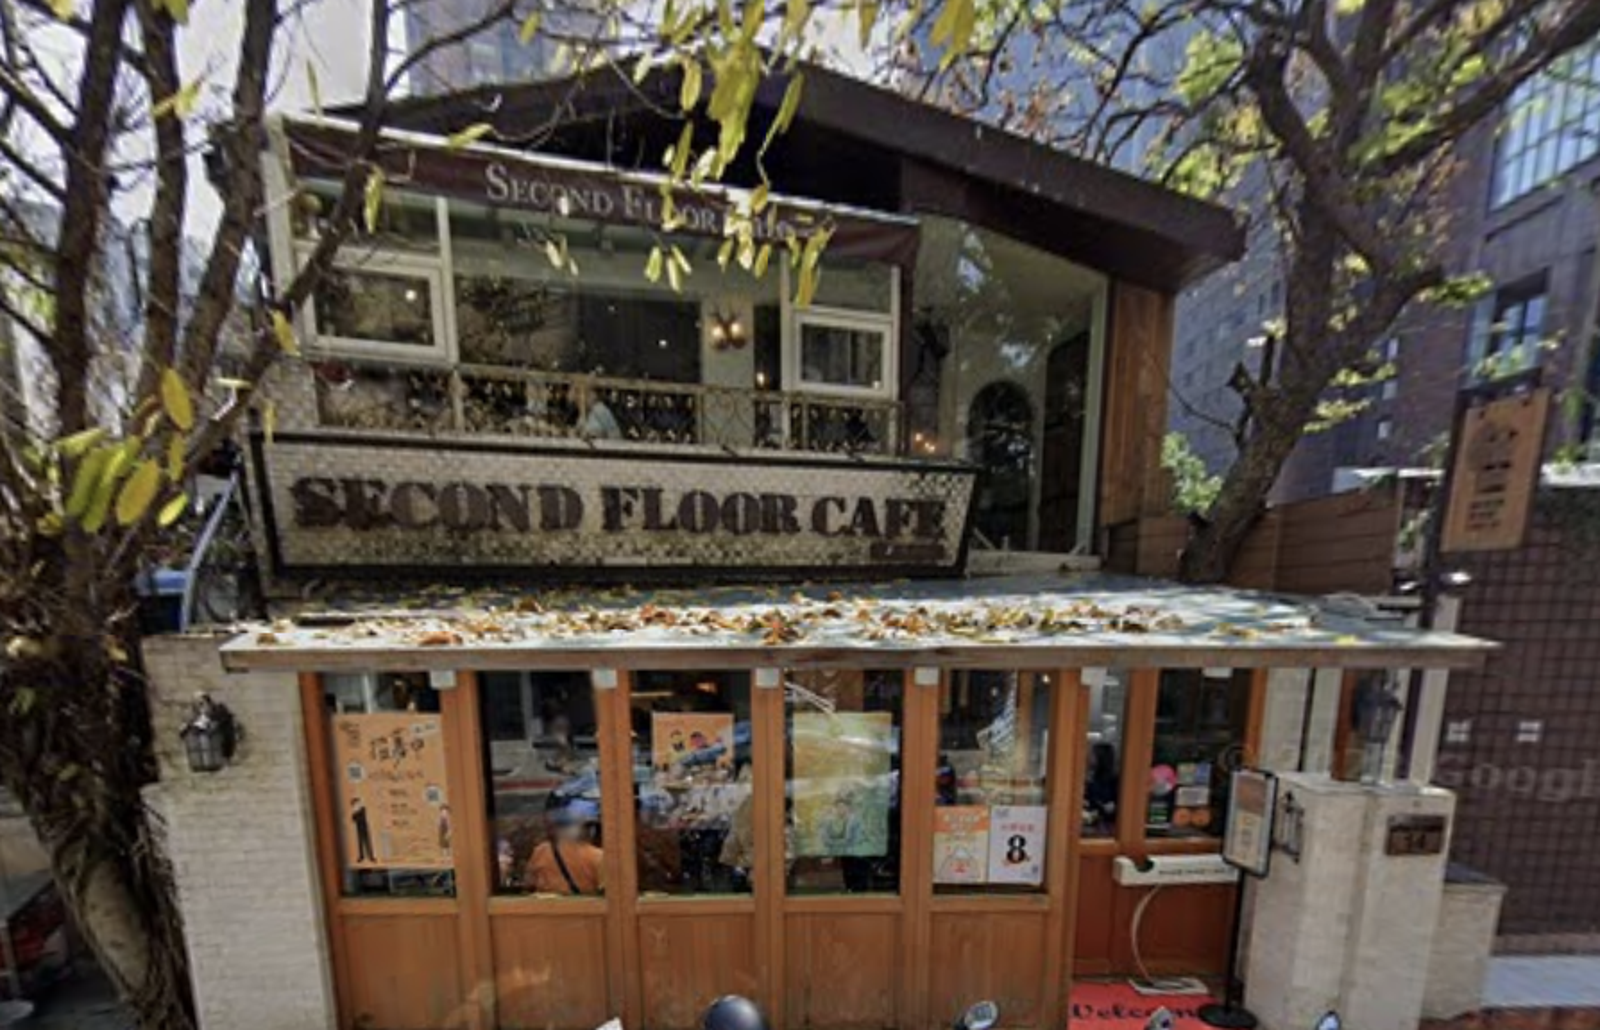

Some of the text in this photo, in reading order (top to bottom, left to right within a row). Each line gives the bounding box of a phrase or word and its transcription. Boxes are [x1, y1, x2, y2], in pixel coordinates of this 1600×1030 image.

[293, 476, 947, 540] SECOND FLOOR CAFE
